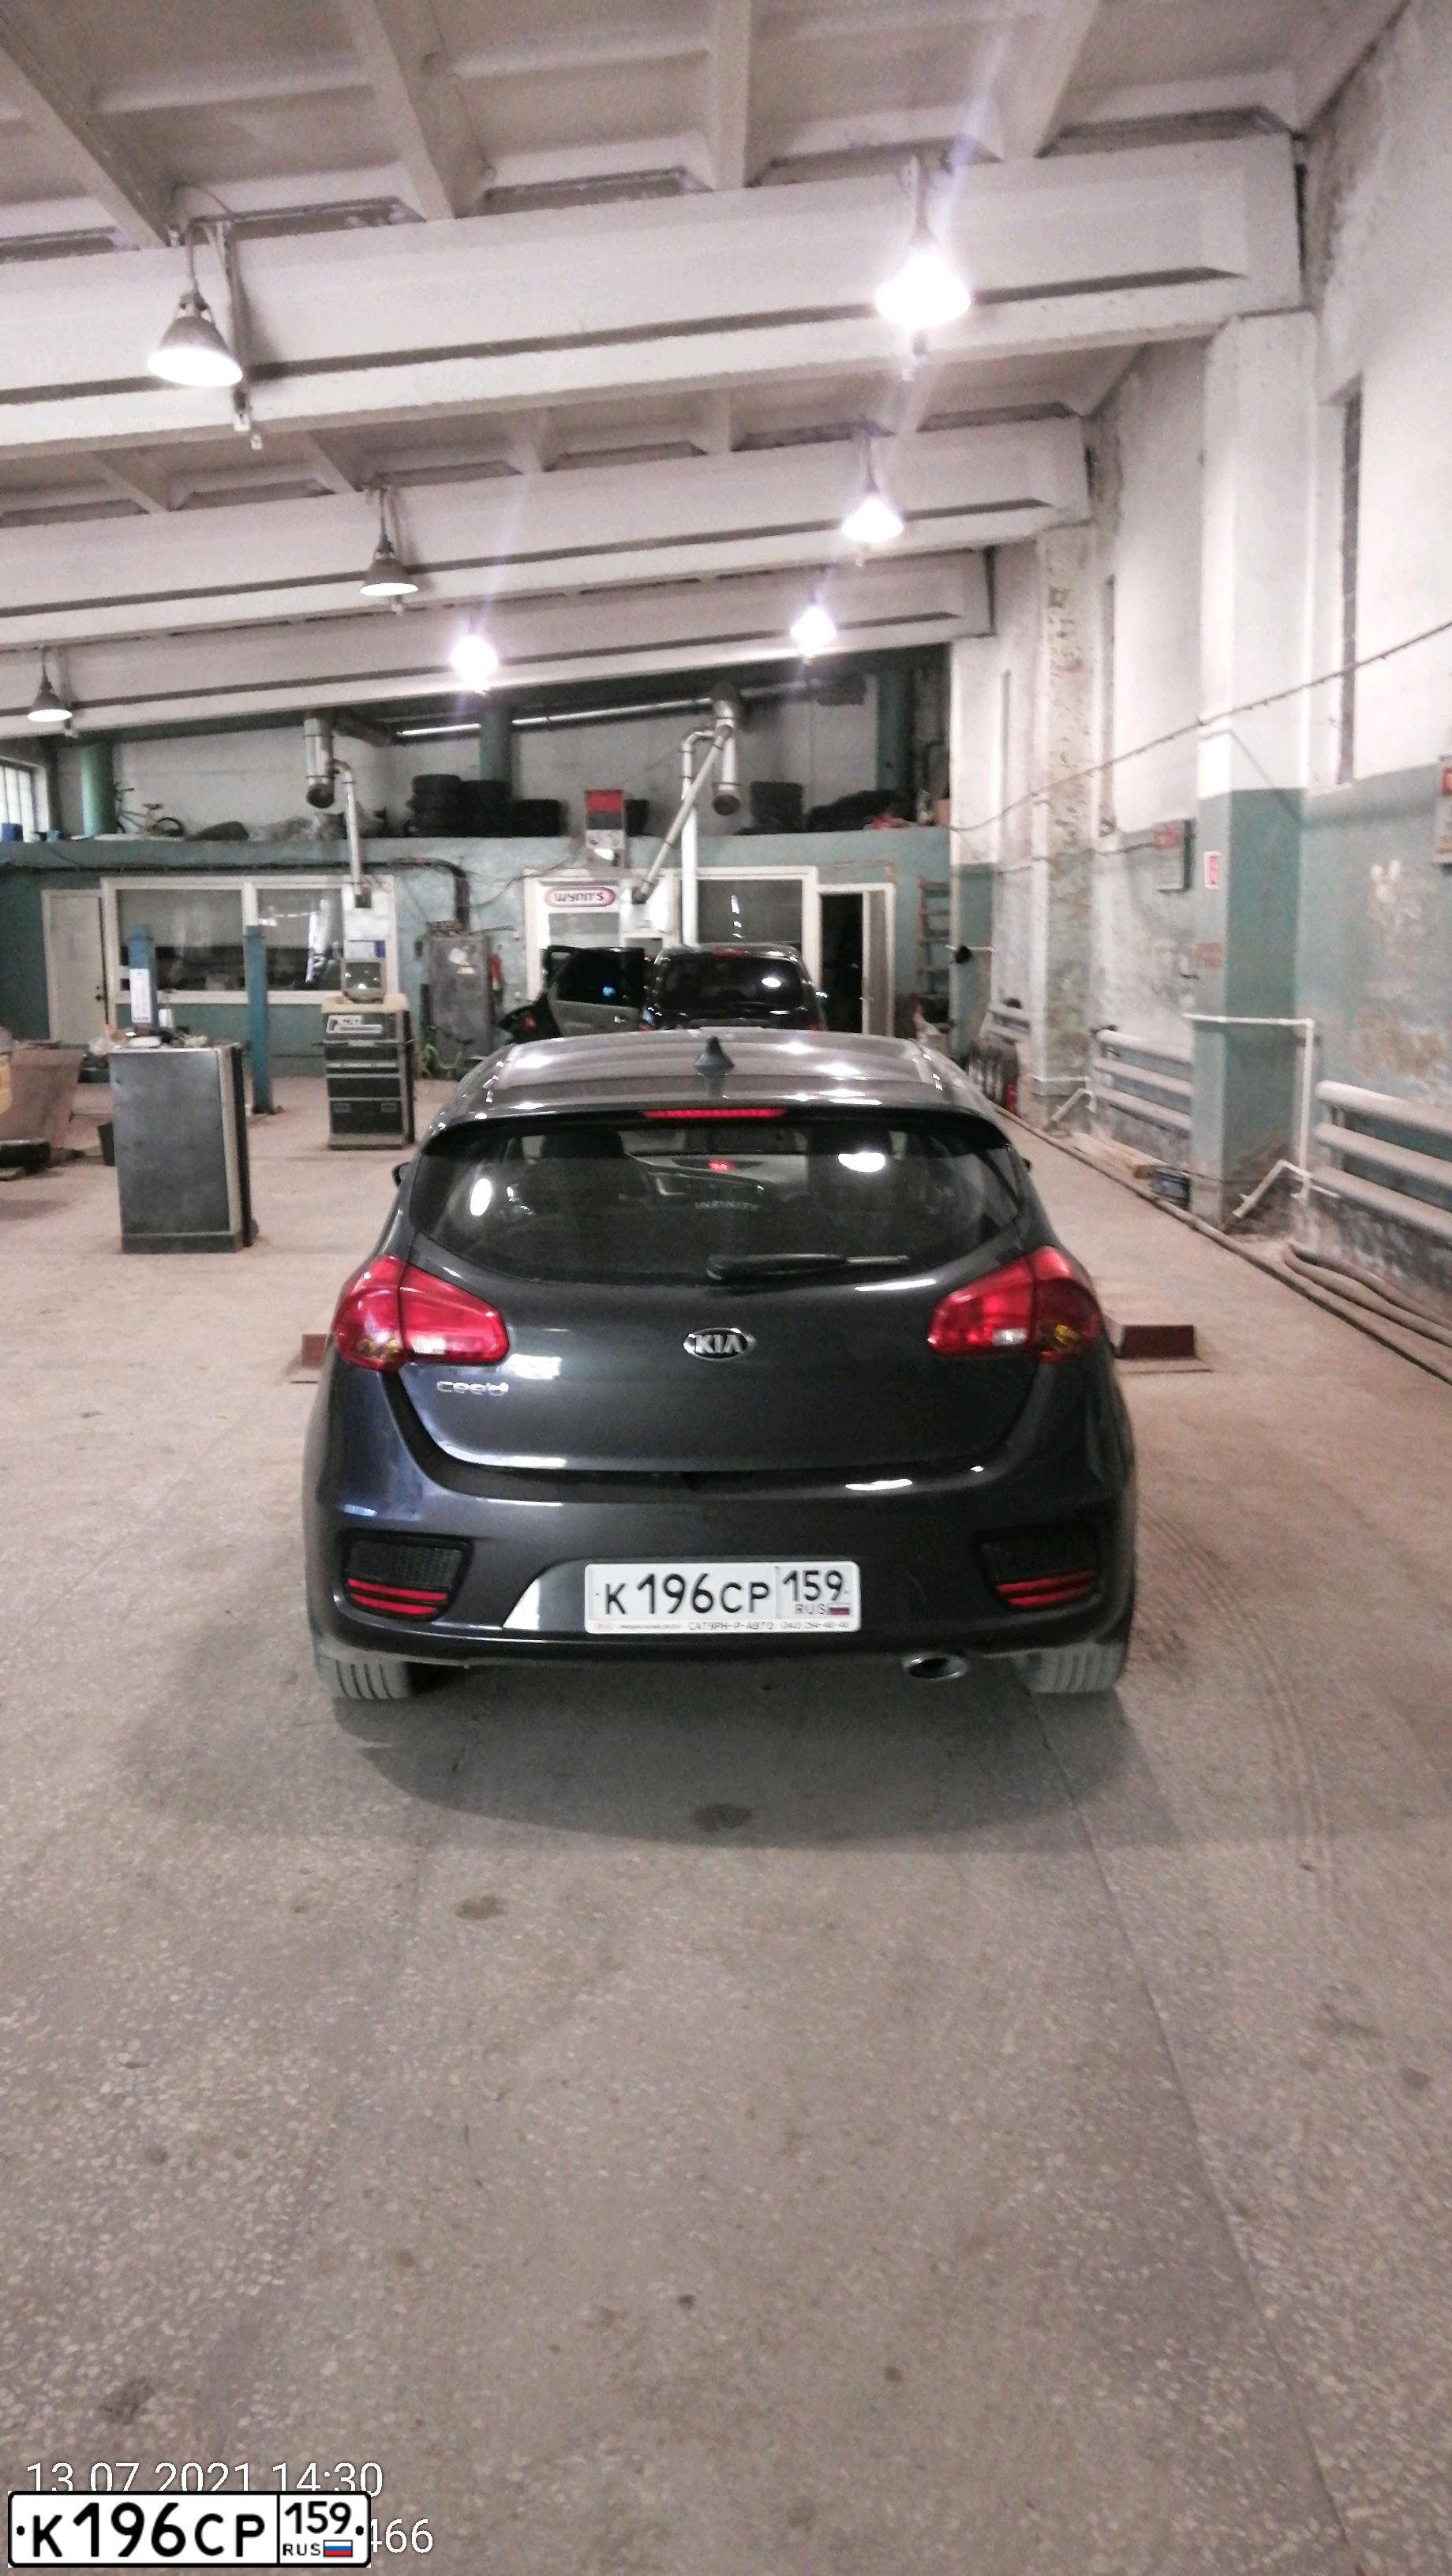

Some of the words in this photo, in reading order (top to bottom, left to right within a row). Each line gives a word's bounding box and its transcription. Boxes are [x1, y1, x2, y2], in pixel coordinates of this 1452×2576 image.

[694, 1334, 741, 1354] KIA
[782, 1569, 844, 1603] 159
[795, 1603, 828, 1615] RUS
